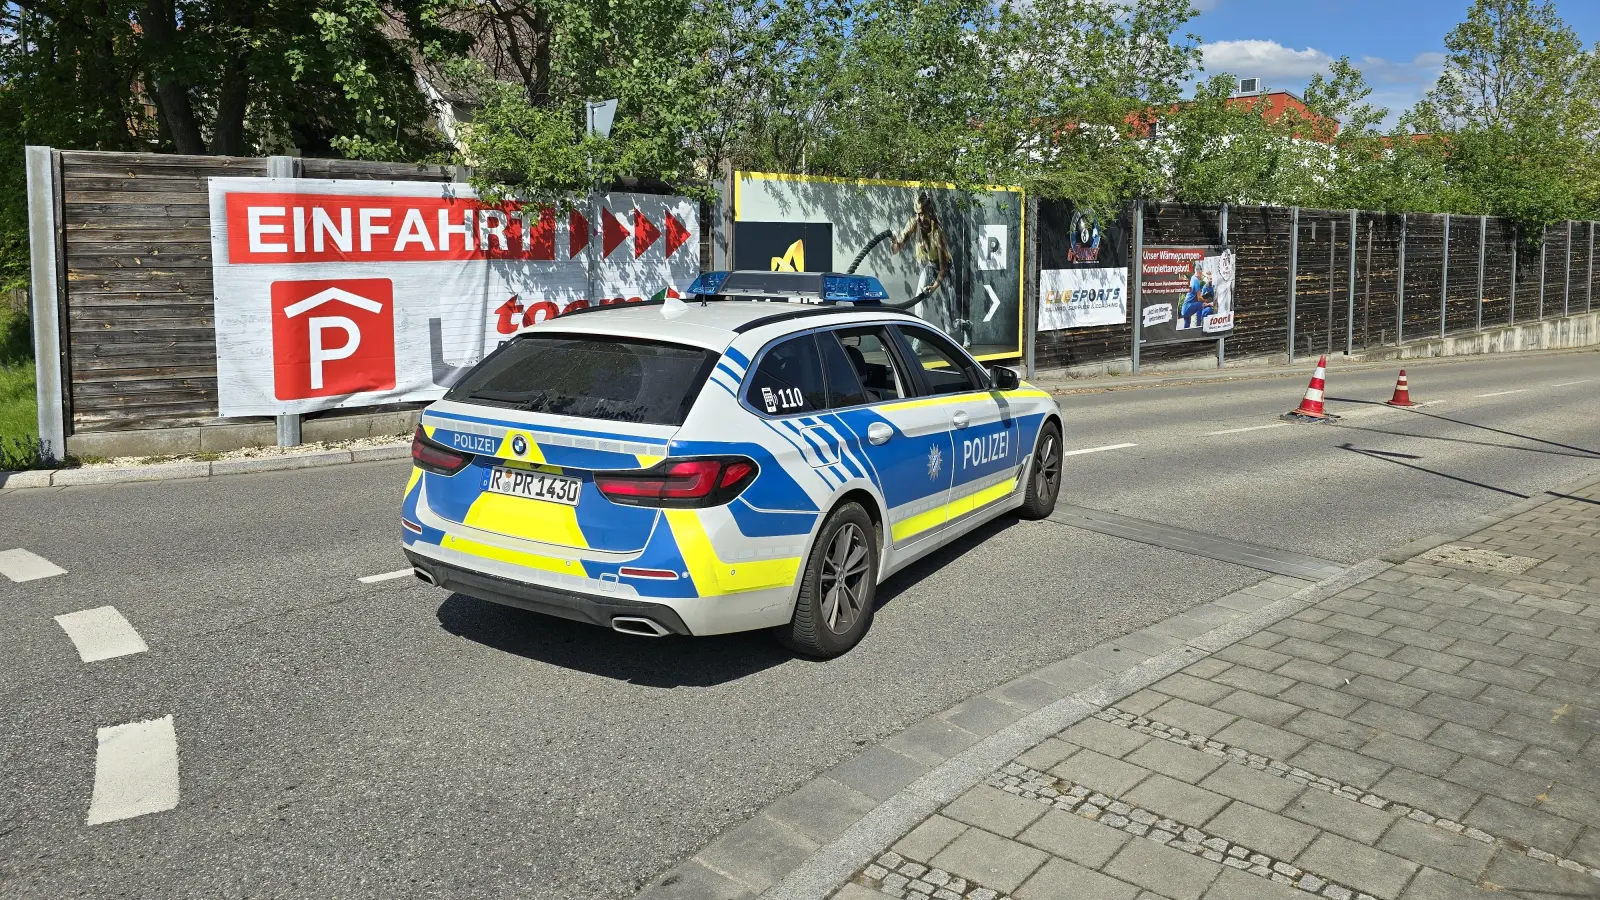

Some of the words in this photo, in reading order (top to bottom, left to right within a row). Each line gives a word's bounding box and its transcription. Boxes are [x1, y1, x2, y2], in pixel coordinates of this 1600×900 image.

[247, 205, 541, 253] EINFAHRT
[987, 236, 999, 260] P
[1142, 251, 1159, 260] Unser
[1159, 250, 1202, 262] Wärmepumpen-
[1142, 263, 1190, 275] Komplettangebot!
[308, 316, 362, 389] P
[778, 387, 804, 408] 110
[453, 433, 495, 453] POLIZEI
[963, 430, 1009, 470] POLIZEI
[491, 469, 503, 490] R
[512, 472, 534, 495] PR
[535, 475, 579, 502] 1430
